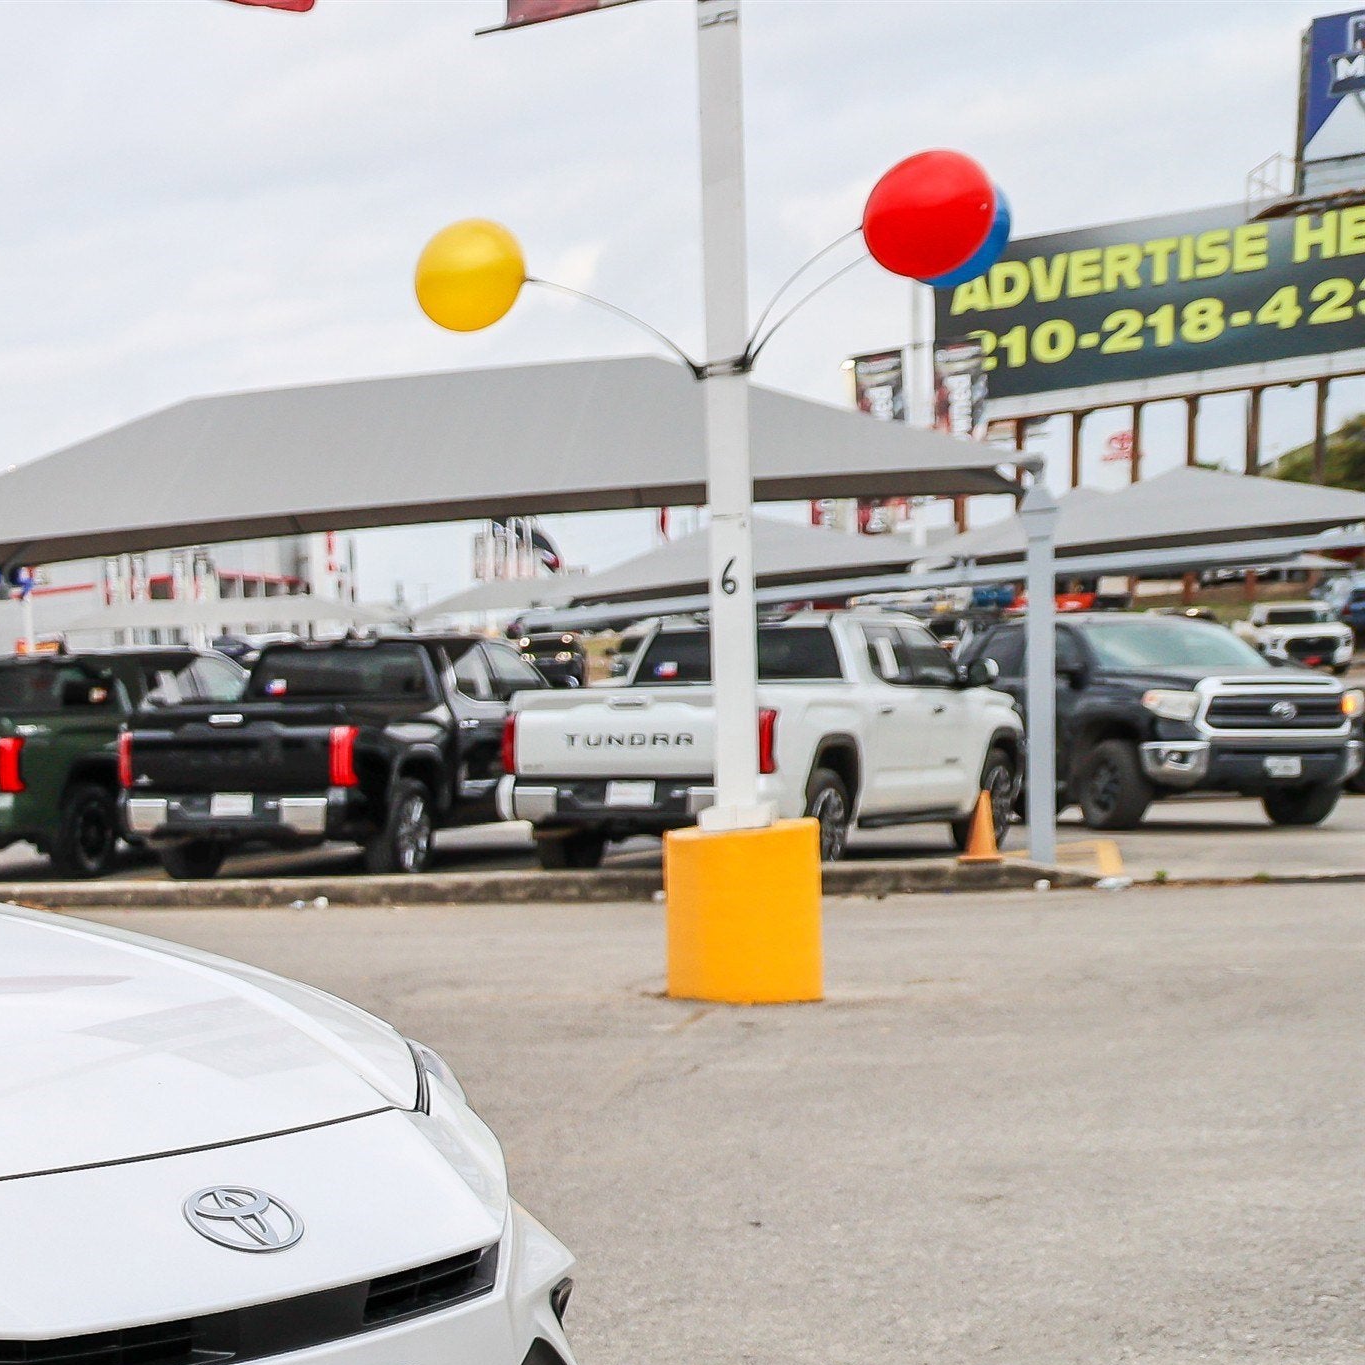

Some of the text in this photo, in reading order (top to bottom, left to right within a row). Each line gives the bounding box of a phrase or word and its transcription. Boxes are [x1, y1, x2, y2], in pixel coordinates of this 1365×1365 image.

[950, 221, 1269, 316] ADVERTISE
[722, 557, 736, 594] 6
[565, 732, 694, 747] TUNDRA
